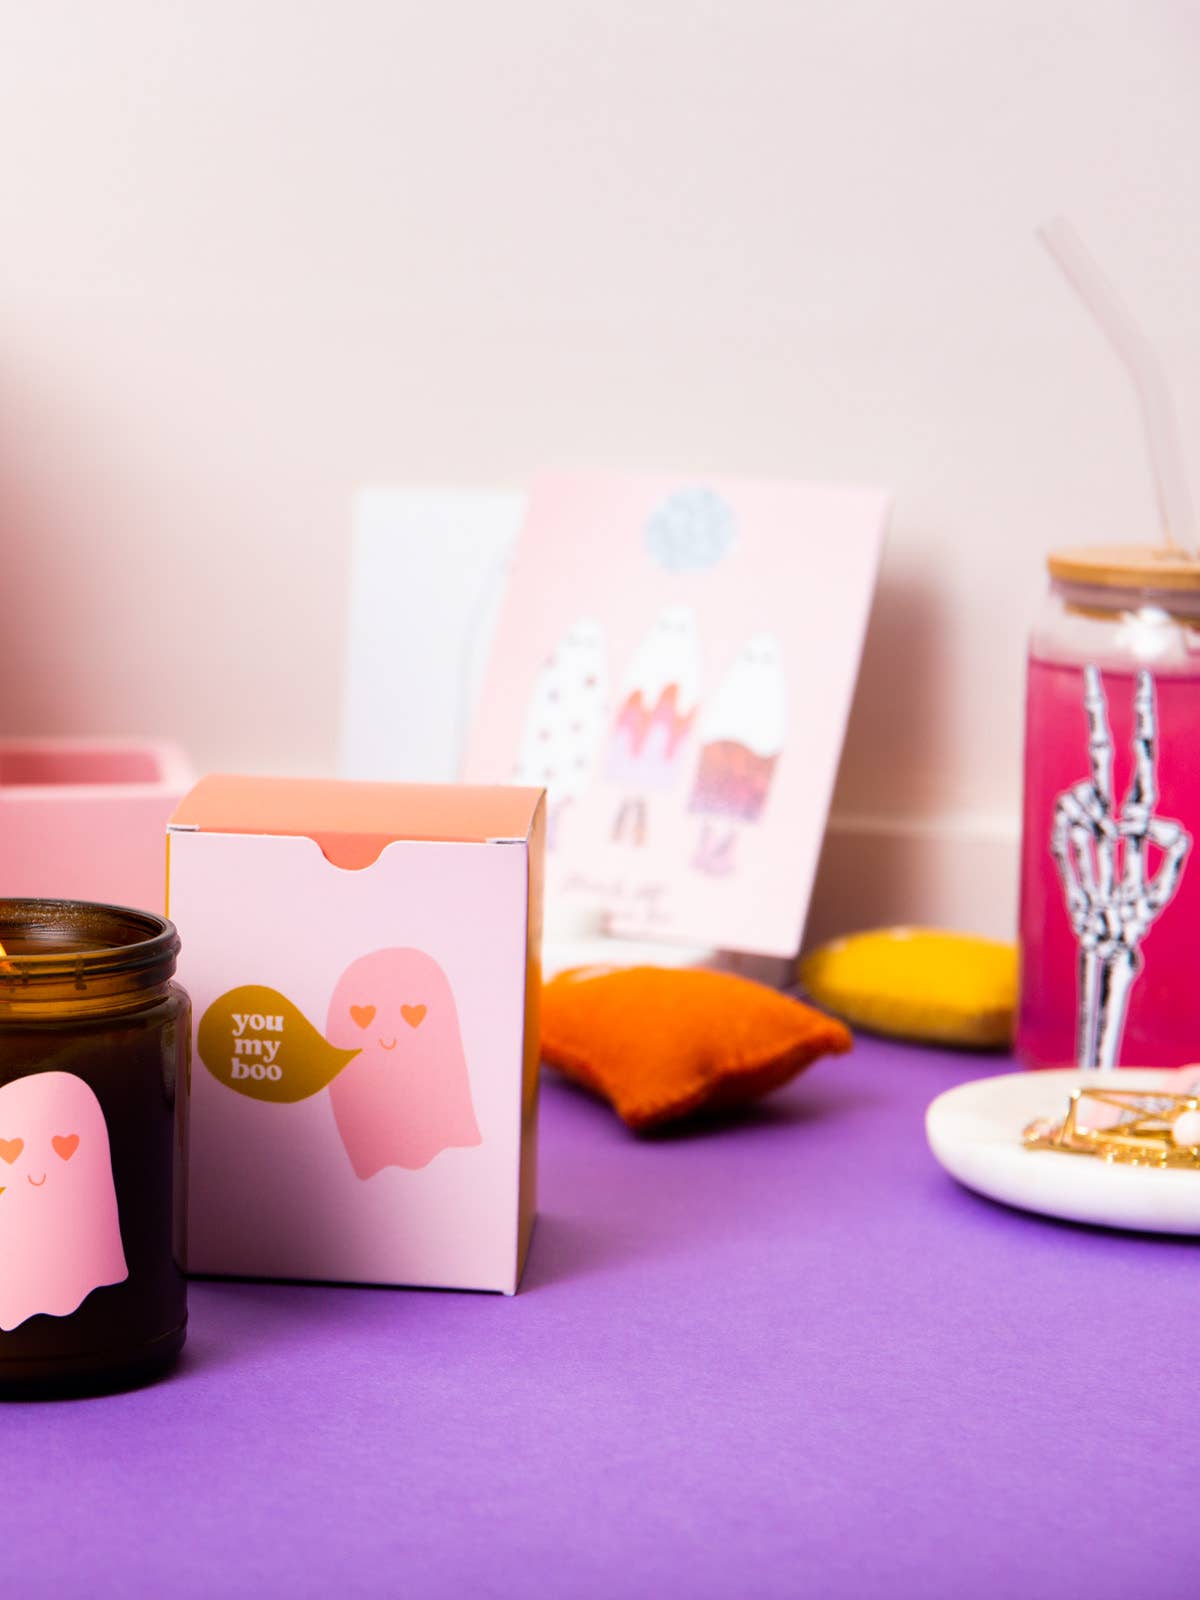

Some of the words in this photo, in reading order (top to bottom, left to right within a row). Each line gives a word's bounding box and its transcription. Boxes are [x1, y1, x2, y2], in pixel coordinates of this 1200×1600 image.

[232, 1013, 283, 1036] you
[234, 1038, 281, 1063] my
[231, 1057, 282, 1081] boo
